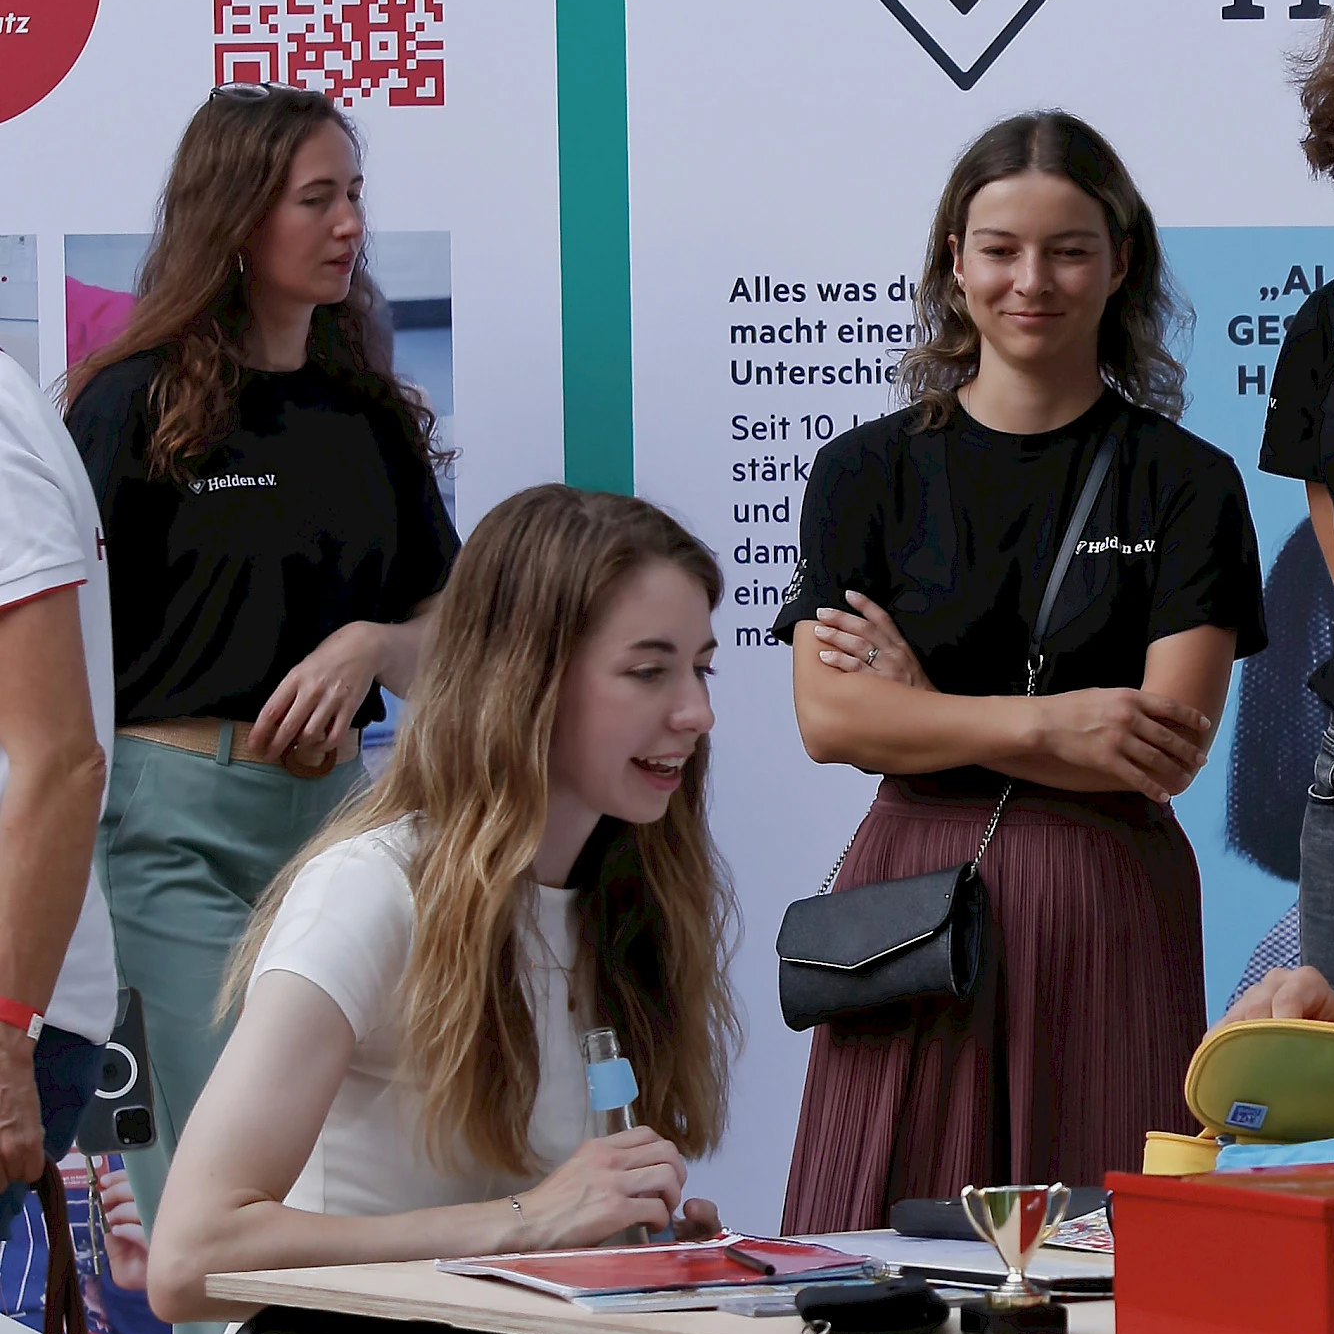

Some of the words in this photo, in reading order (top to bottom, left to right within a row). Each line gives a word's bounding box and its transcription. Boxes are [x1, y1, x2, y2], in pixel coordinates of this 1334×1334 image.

[729, 275, 807, 303] Alles
[816, 282, 877, 302] was
[730, 317, 827, 344] macht
[731, 414, 791, 441] Seit
[800, 415, 834, 441] 10
[207, 474, 256, 492] Helden
[258, 474, 277, 486] e.V.
[733, 496, 790, 523] und
[1087, 536, 1132, 554] Heldn
[1134, 539, 1156, 553] e.V.
